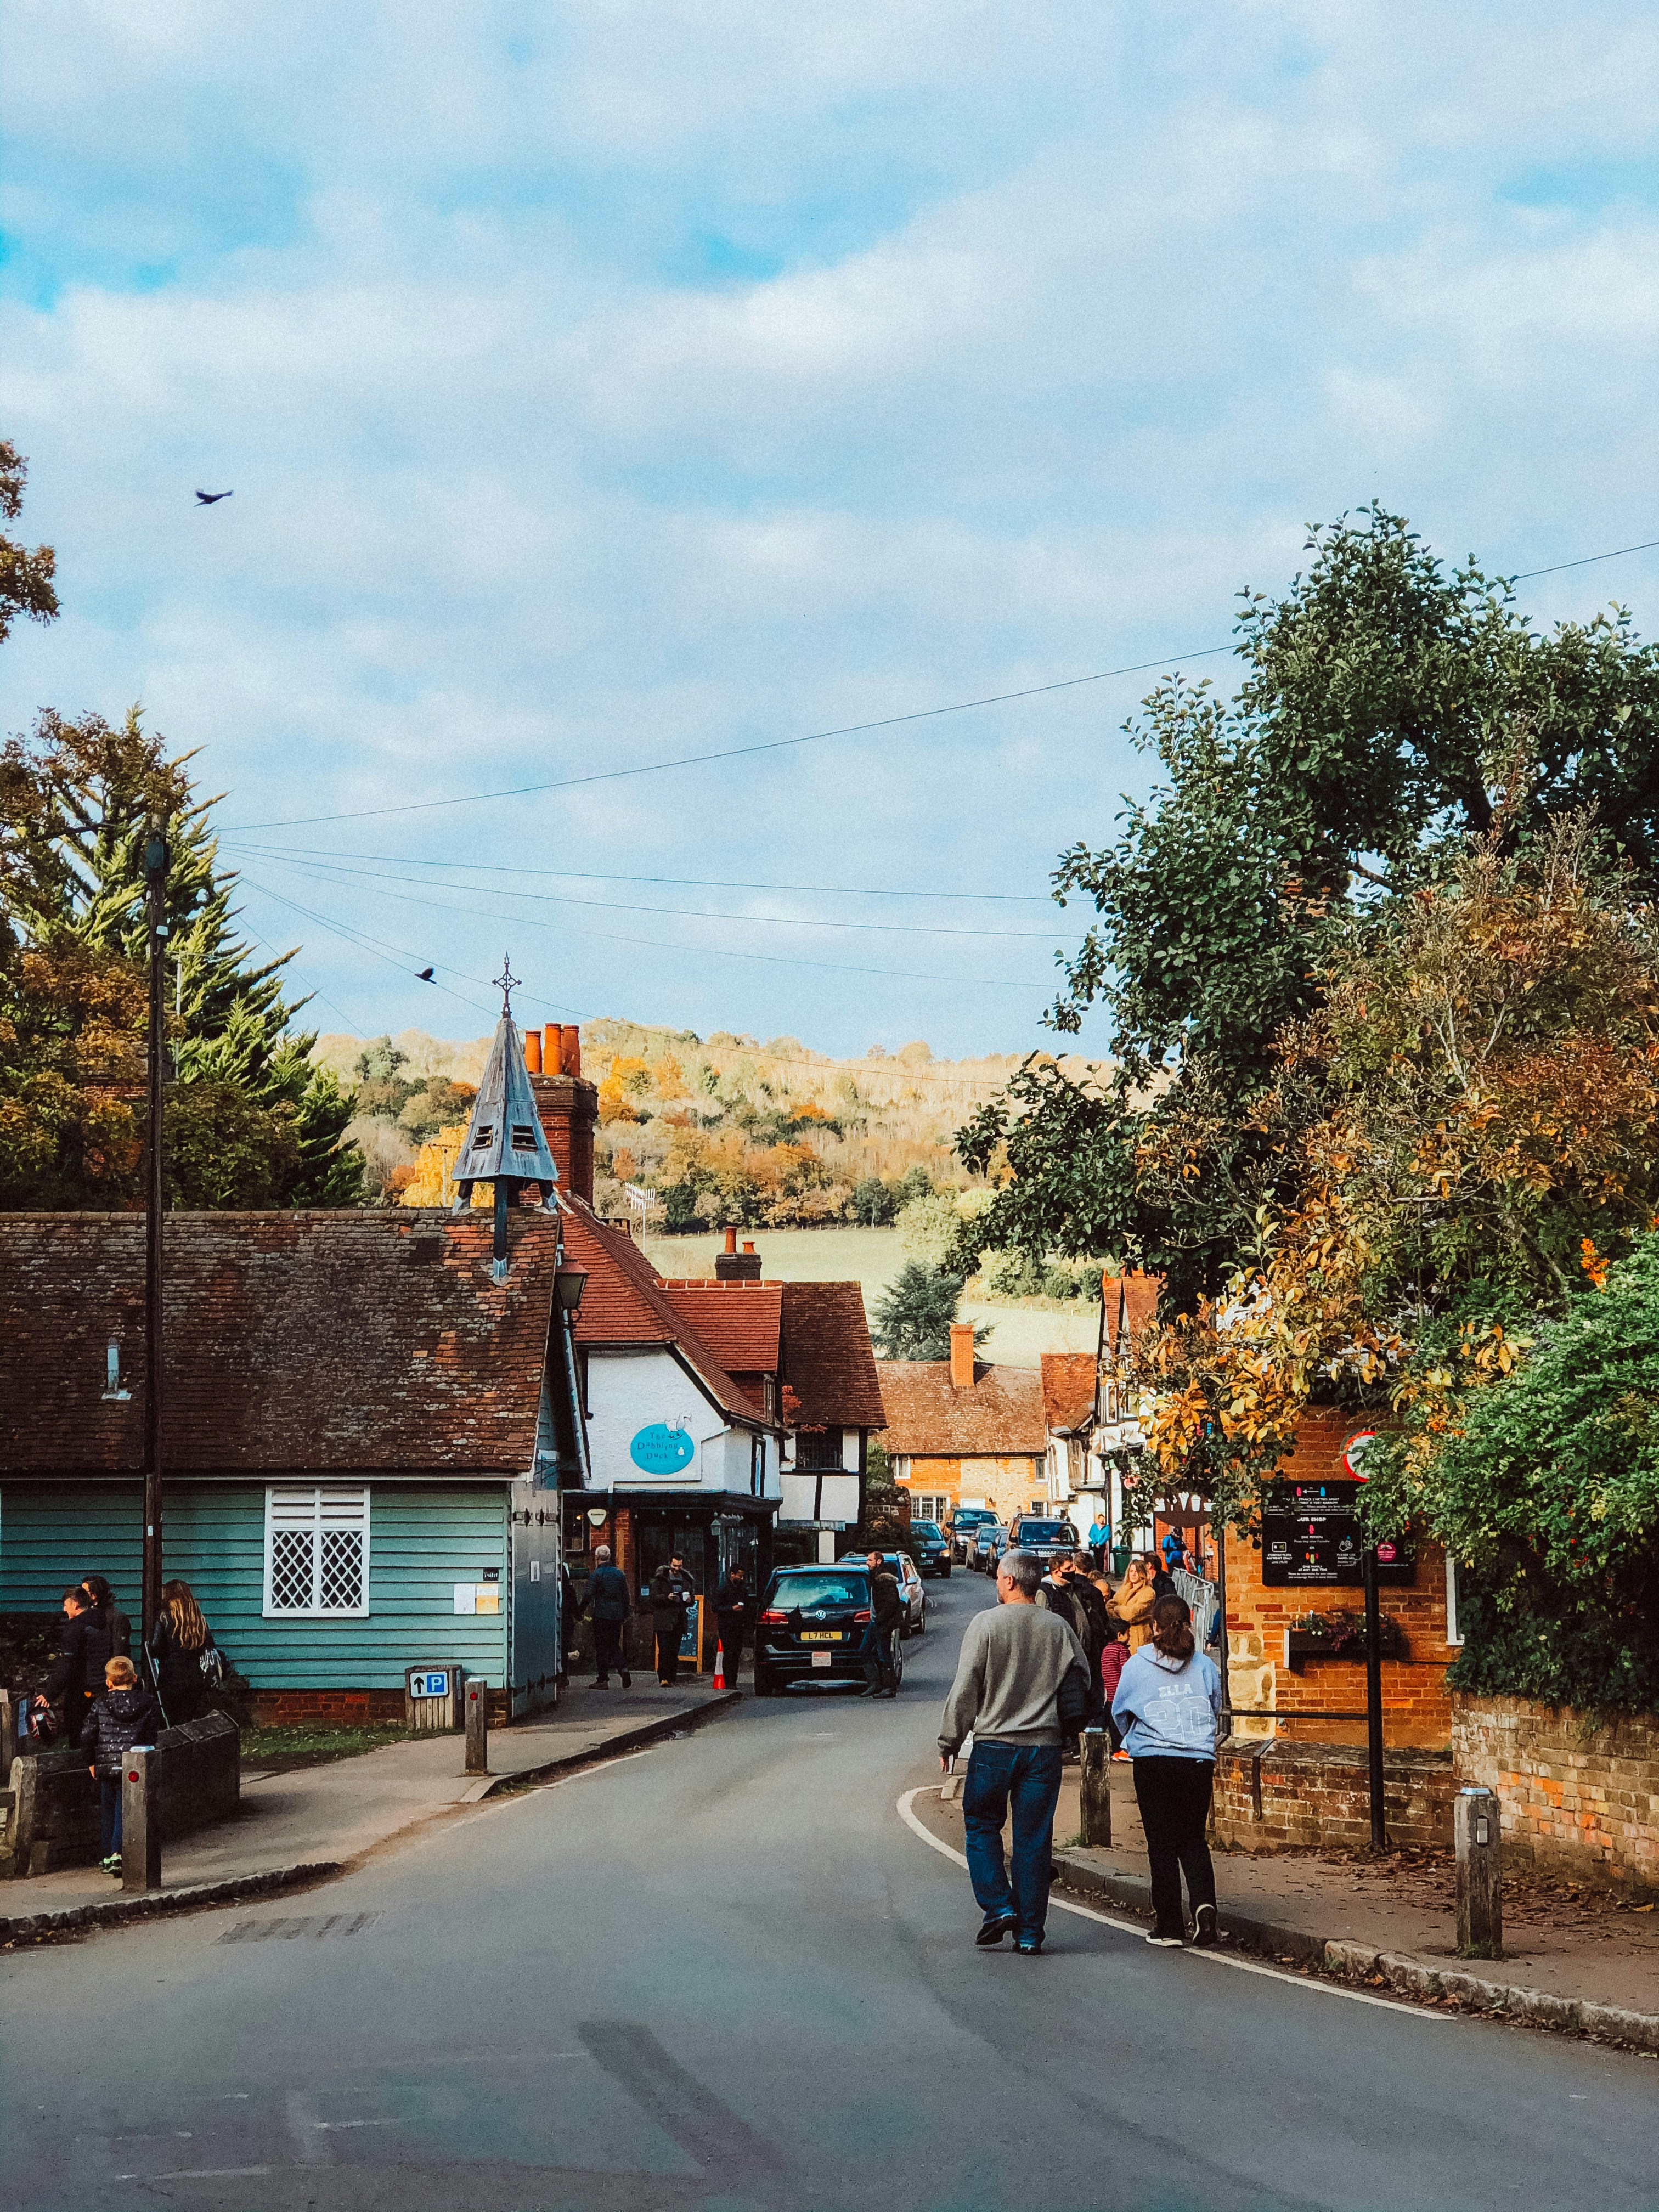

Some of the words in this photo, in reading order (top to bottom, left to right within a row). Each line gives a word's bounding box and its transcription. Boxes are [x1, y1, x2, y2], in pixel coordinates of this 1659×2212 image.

[650, 1432, 665, 1440] The
[637, 1442, 678, 1451] Dabbling
[431, 1677, 442, 1691] P
[1158, 1684, 1193, 1698] ELLA
